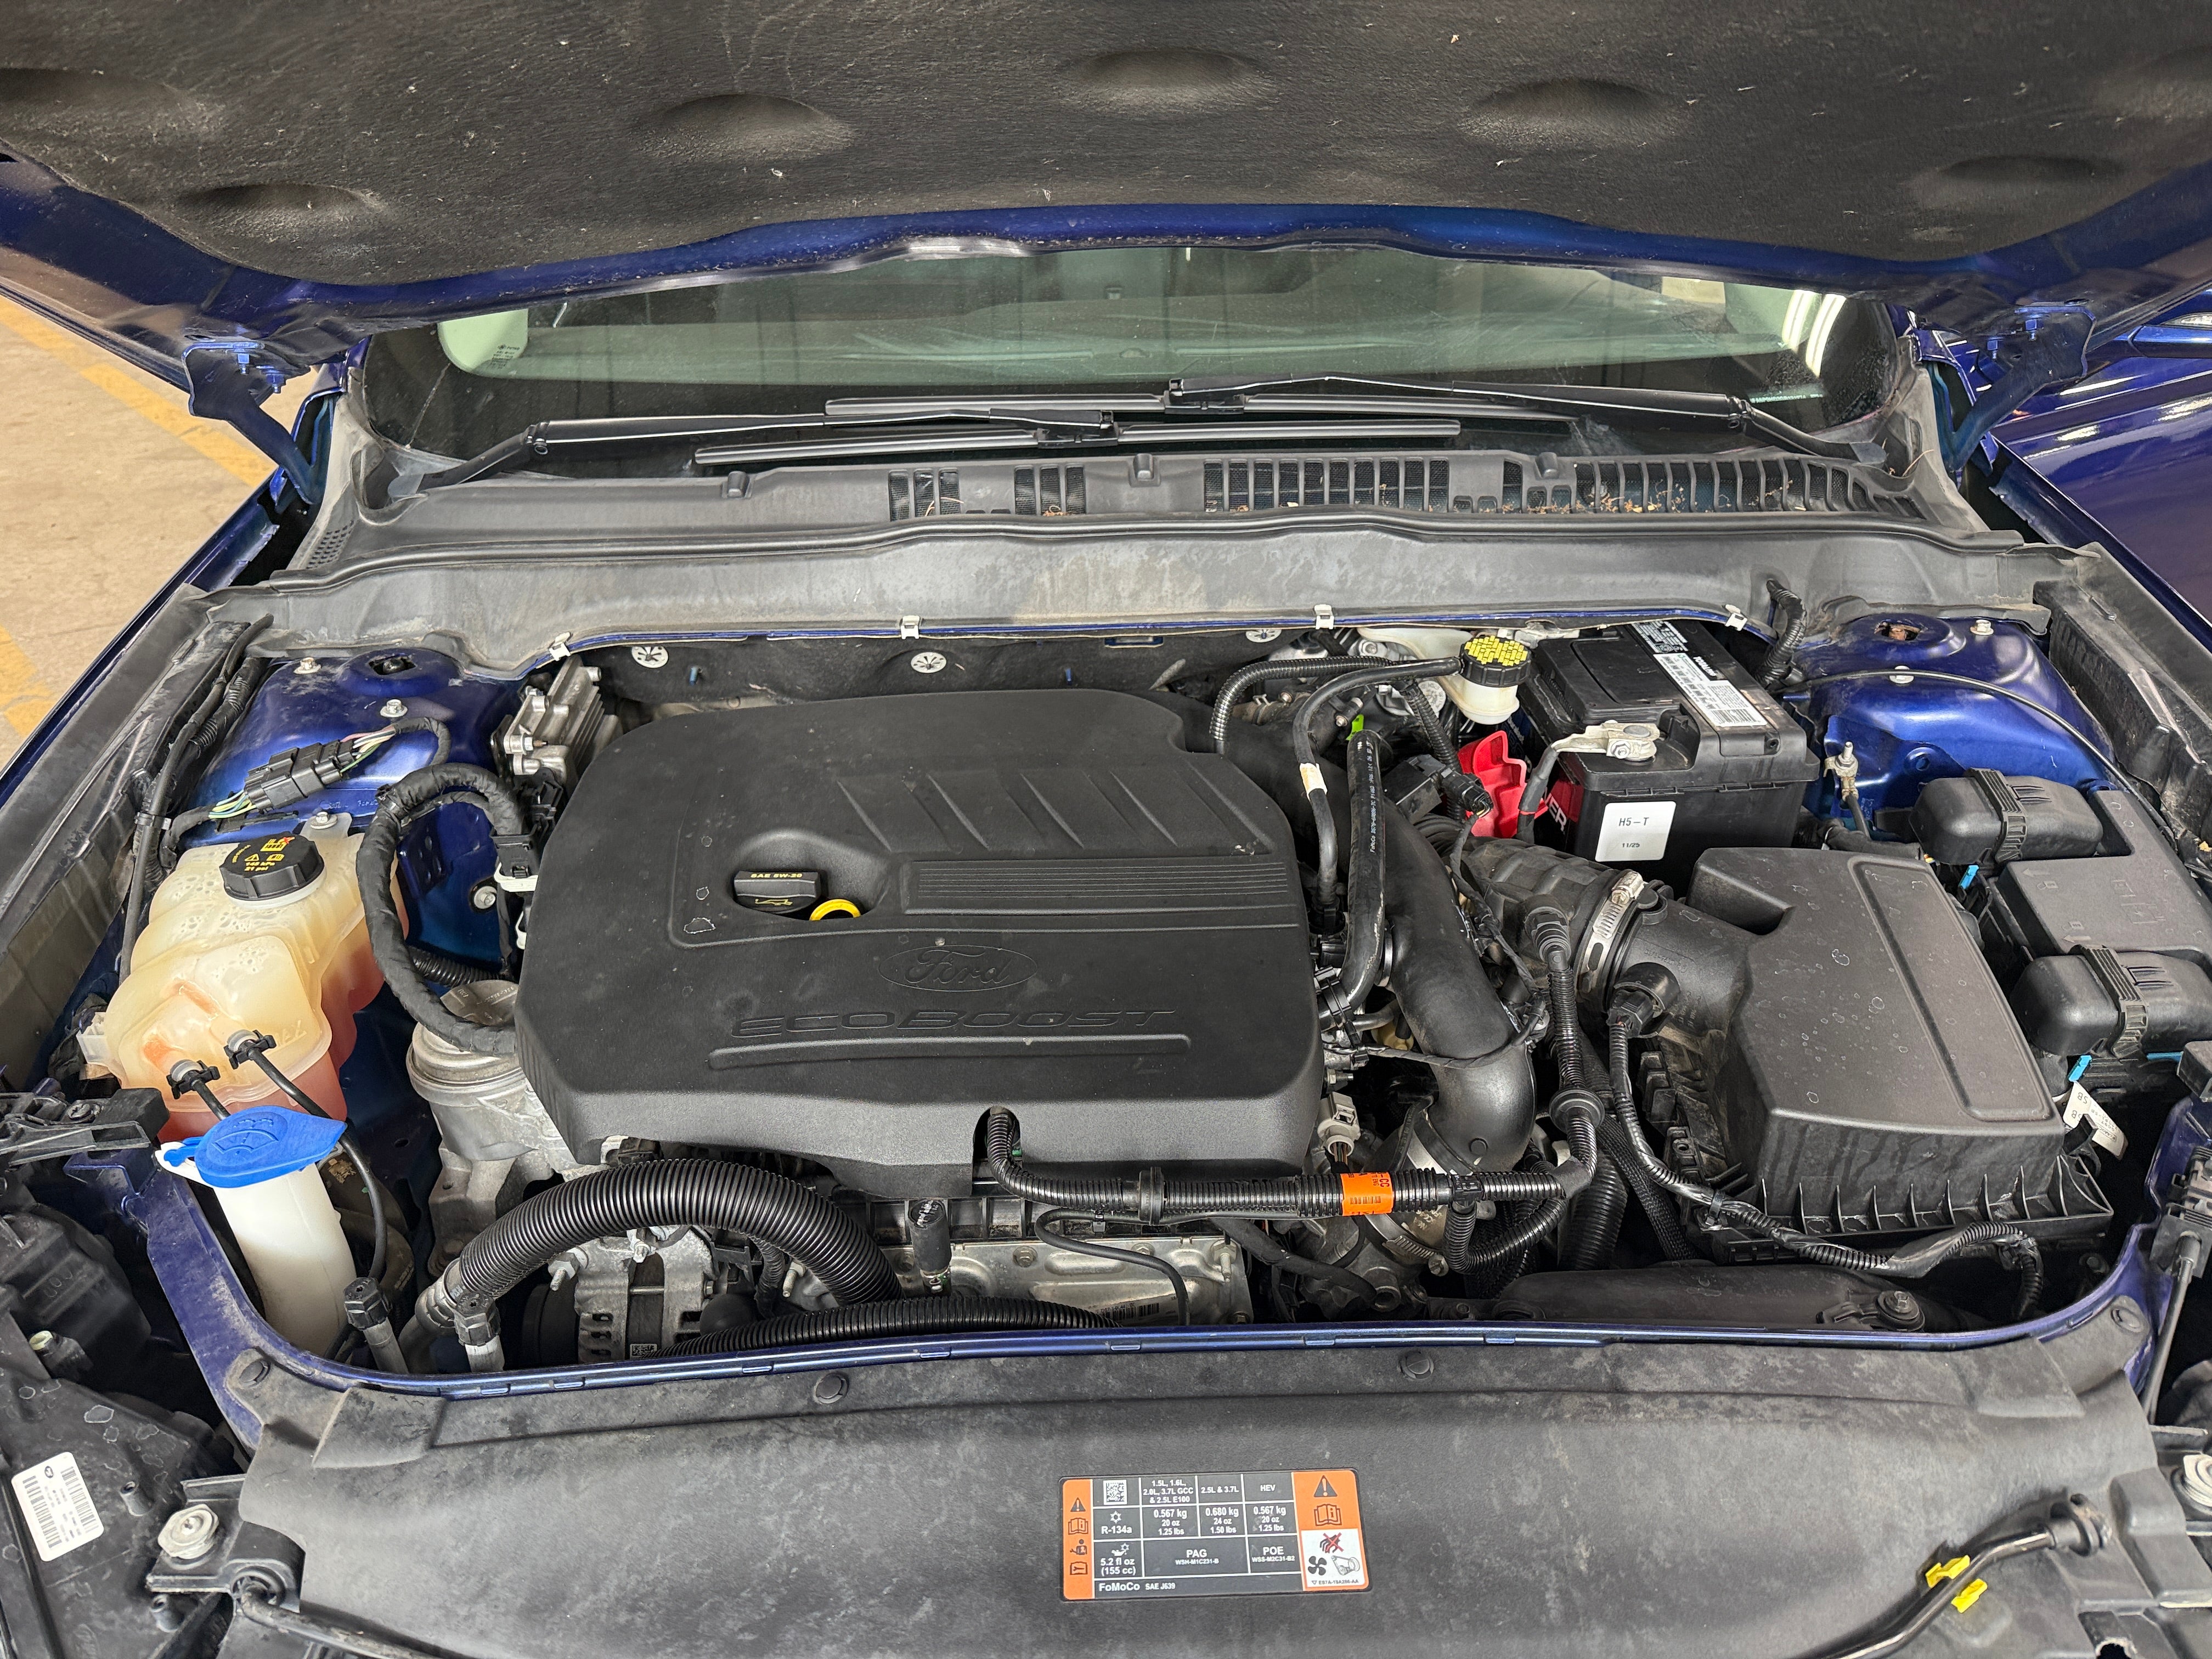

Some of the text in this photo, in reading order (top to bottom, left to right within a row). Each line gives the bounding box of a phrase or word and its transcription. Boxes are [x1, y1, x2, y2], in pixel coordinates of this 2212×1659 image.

[905, 949, 1013, 984] Ford
[1154, 1509, 1187, 1519] 0.567 kg
[1205, 1508, 1239, 1517] 0.680 kg
[1254, 1505, 1286, 1515] 0.567 kg
[1101, 1526, 1132, 1534] R-134a
[1186, 1549, 1207, 1558] PAG
[1263, 1546, 1284, 1555] POE
[1101, 1558, 1114, 1566] 5.2
[1101, 1566, 1136, 1576] (155 cc)
[1099, 1582, 1141, 1592] FoMoCo
